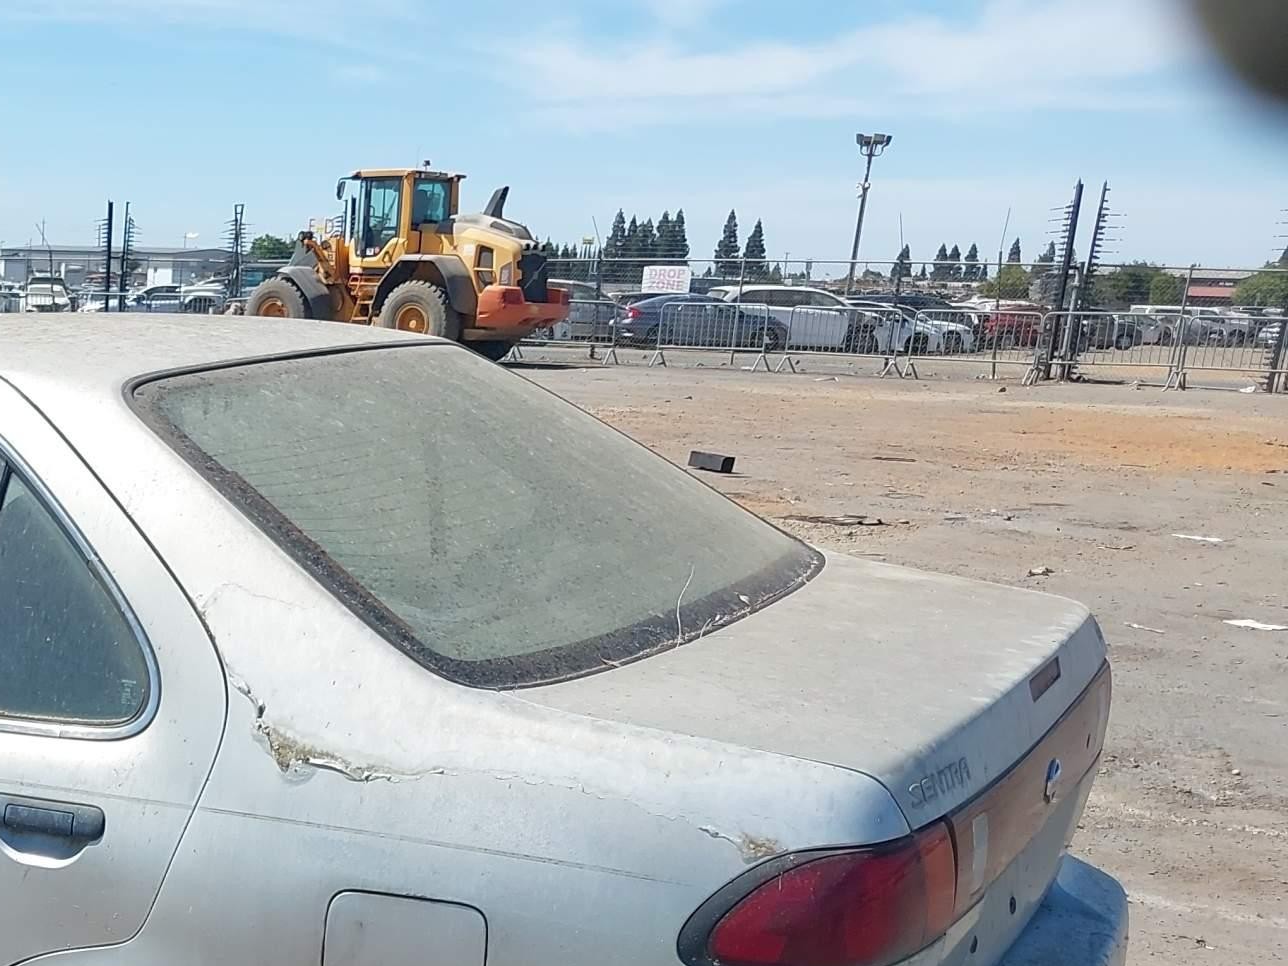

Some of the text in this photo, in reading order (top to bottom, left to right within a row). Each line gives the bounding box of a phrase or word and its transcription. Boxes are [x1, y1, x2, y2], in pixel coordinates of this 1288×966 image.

[648, 268, 686, 280] DROP
[648, 280, 684, 291] ZONE
[907, 756, 971, 810] SENTRA
